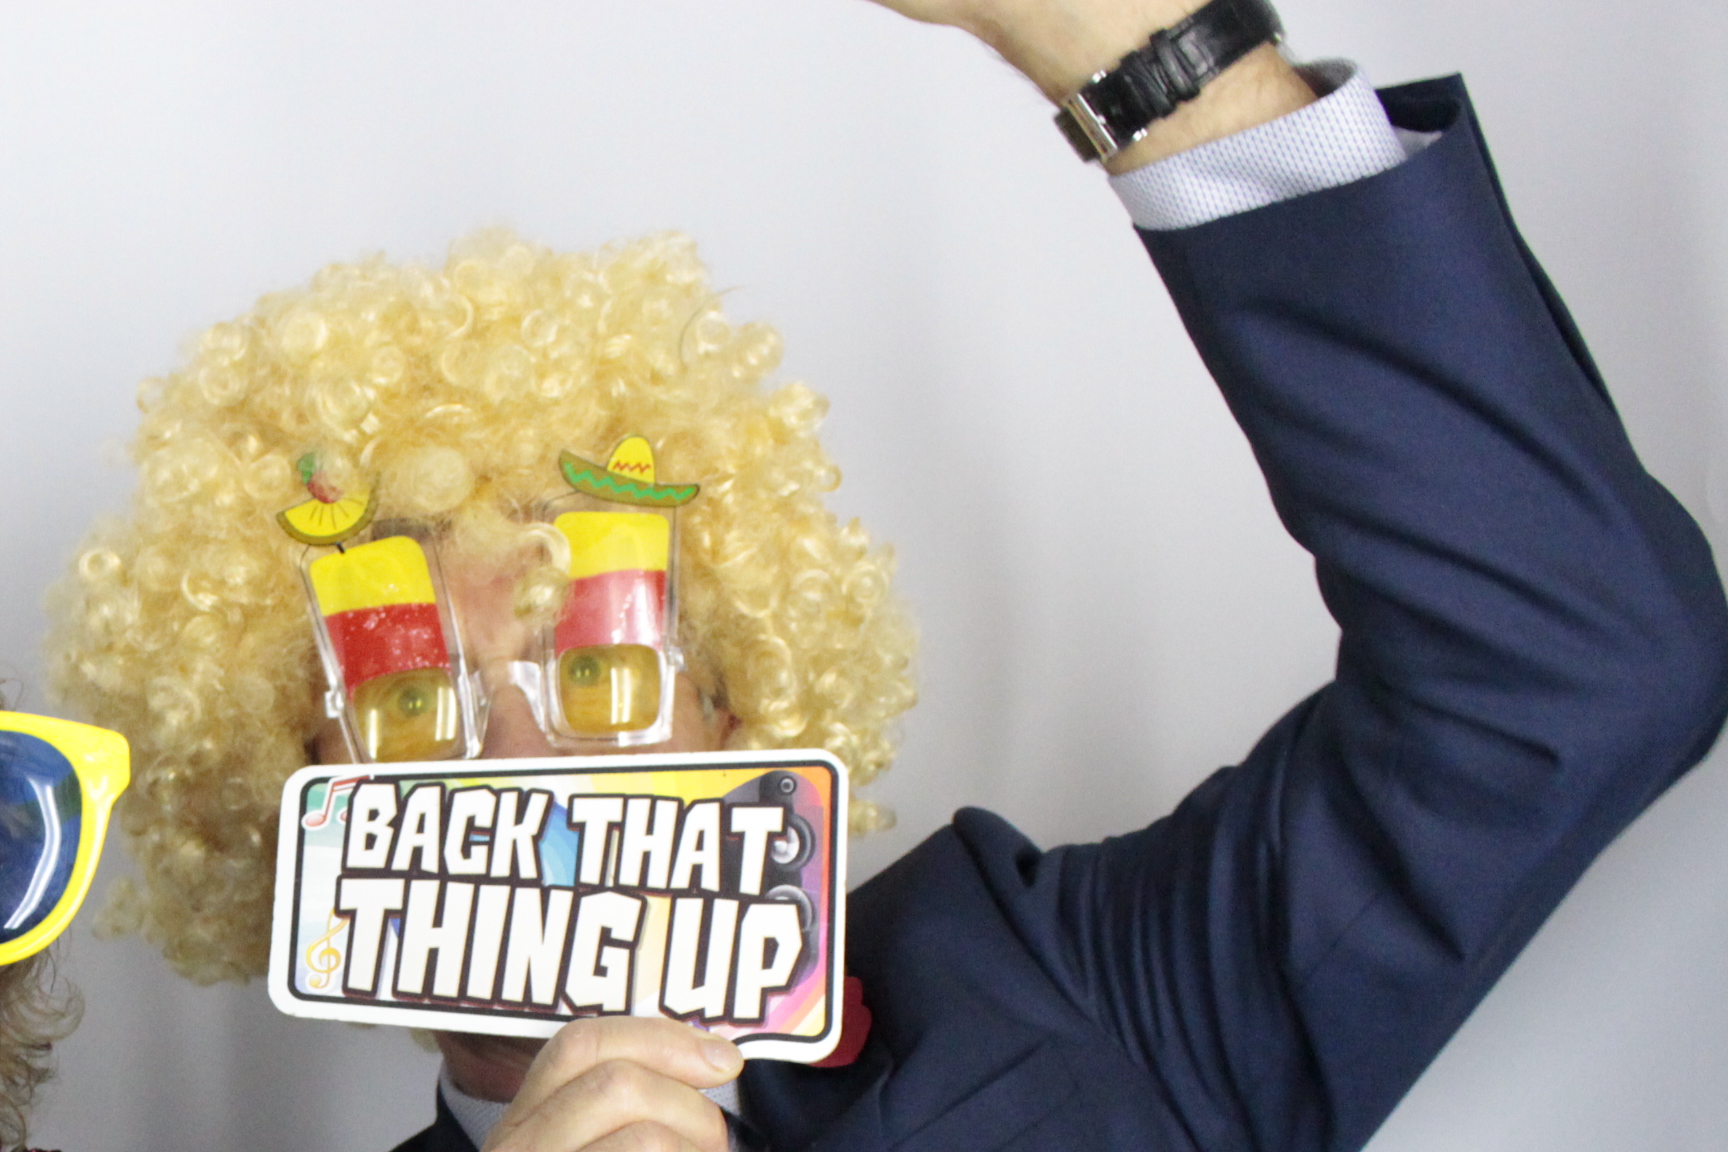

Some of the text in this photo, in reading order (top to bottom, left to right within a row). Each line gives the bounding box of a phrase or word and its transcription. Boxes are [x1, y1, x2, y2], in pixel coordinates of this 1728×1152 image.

[346, 783, 784, 896] BACK THAT
[338, 878, 803, 1020] THING UP
